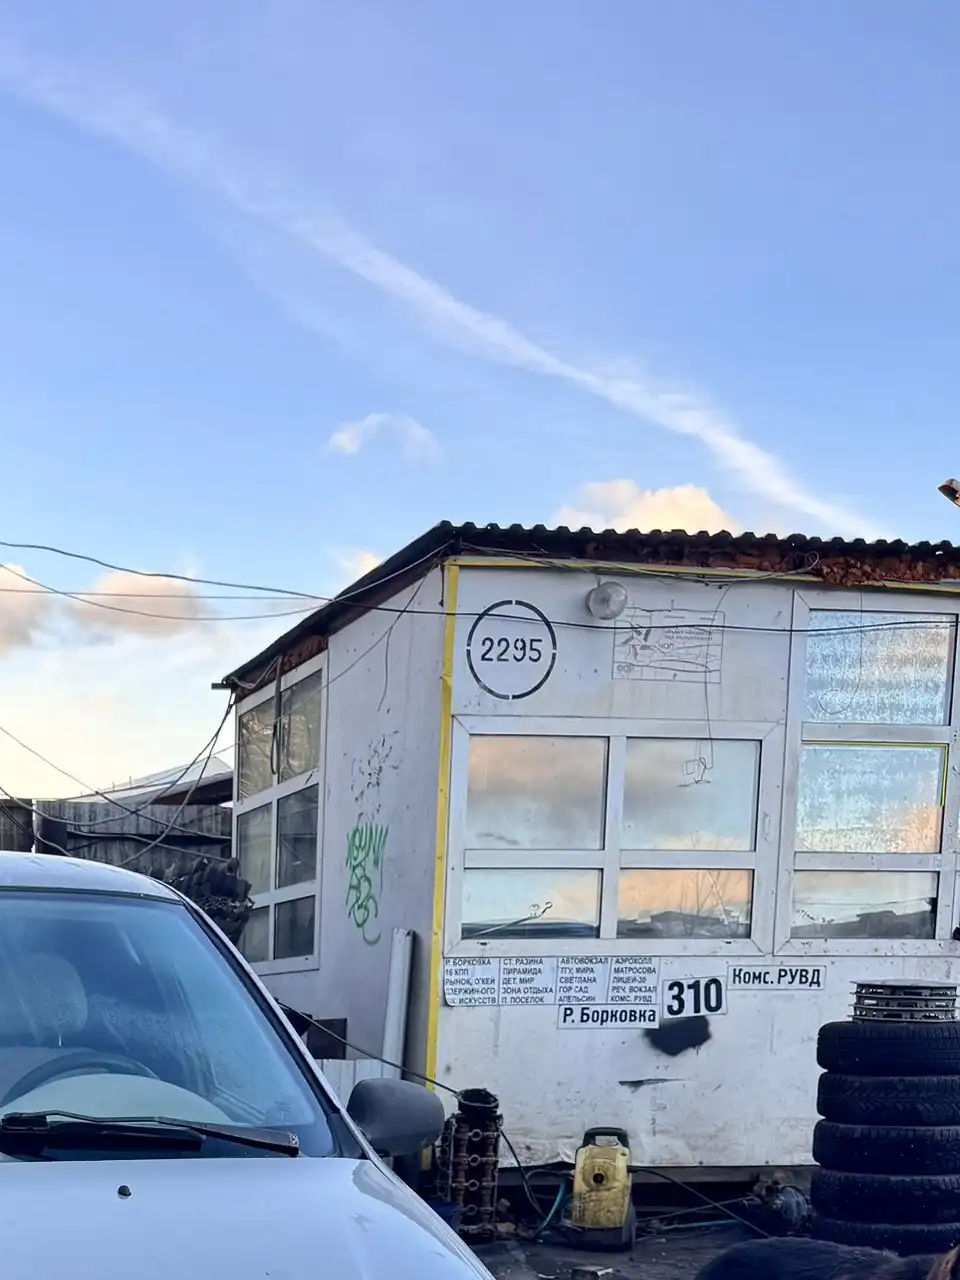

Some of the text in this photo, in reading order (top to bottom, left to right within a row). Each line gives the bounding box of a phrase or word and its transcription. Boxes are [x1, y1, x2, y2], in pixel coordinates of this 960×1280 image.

[480, 636, 543, 663] 2295
[452, 958, 492, 966] БОРКОВКА
[503, 958, 544, 966] СТ. РАЗИНА
[560, 957, 609, 965] АВТОВОКЗАЛ
[502, 967, 543, 975] ПИРАМИДА
[559, 976, 597, 984] СВЕТЛАНА
[732, 967, 821, 988] Комс. РУВД
[501, 987, 554, 995] ЗОНА ОТДЫХА
[574, 986, 589, 994] САД
[458, 997, 497, 1005] ИСКУССТВ
[558, 995, 596, 1003] АПЕЛЬСИН
[634, 995, 652, 1003] РУВД
[666, 978, 723, 1016] 310
[562, 1007, 657, 1026] Р. Борковка
